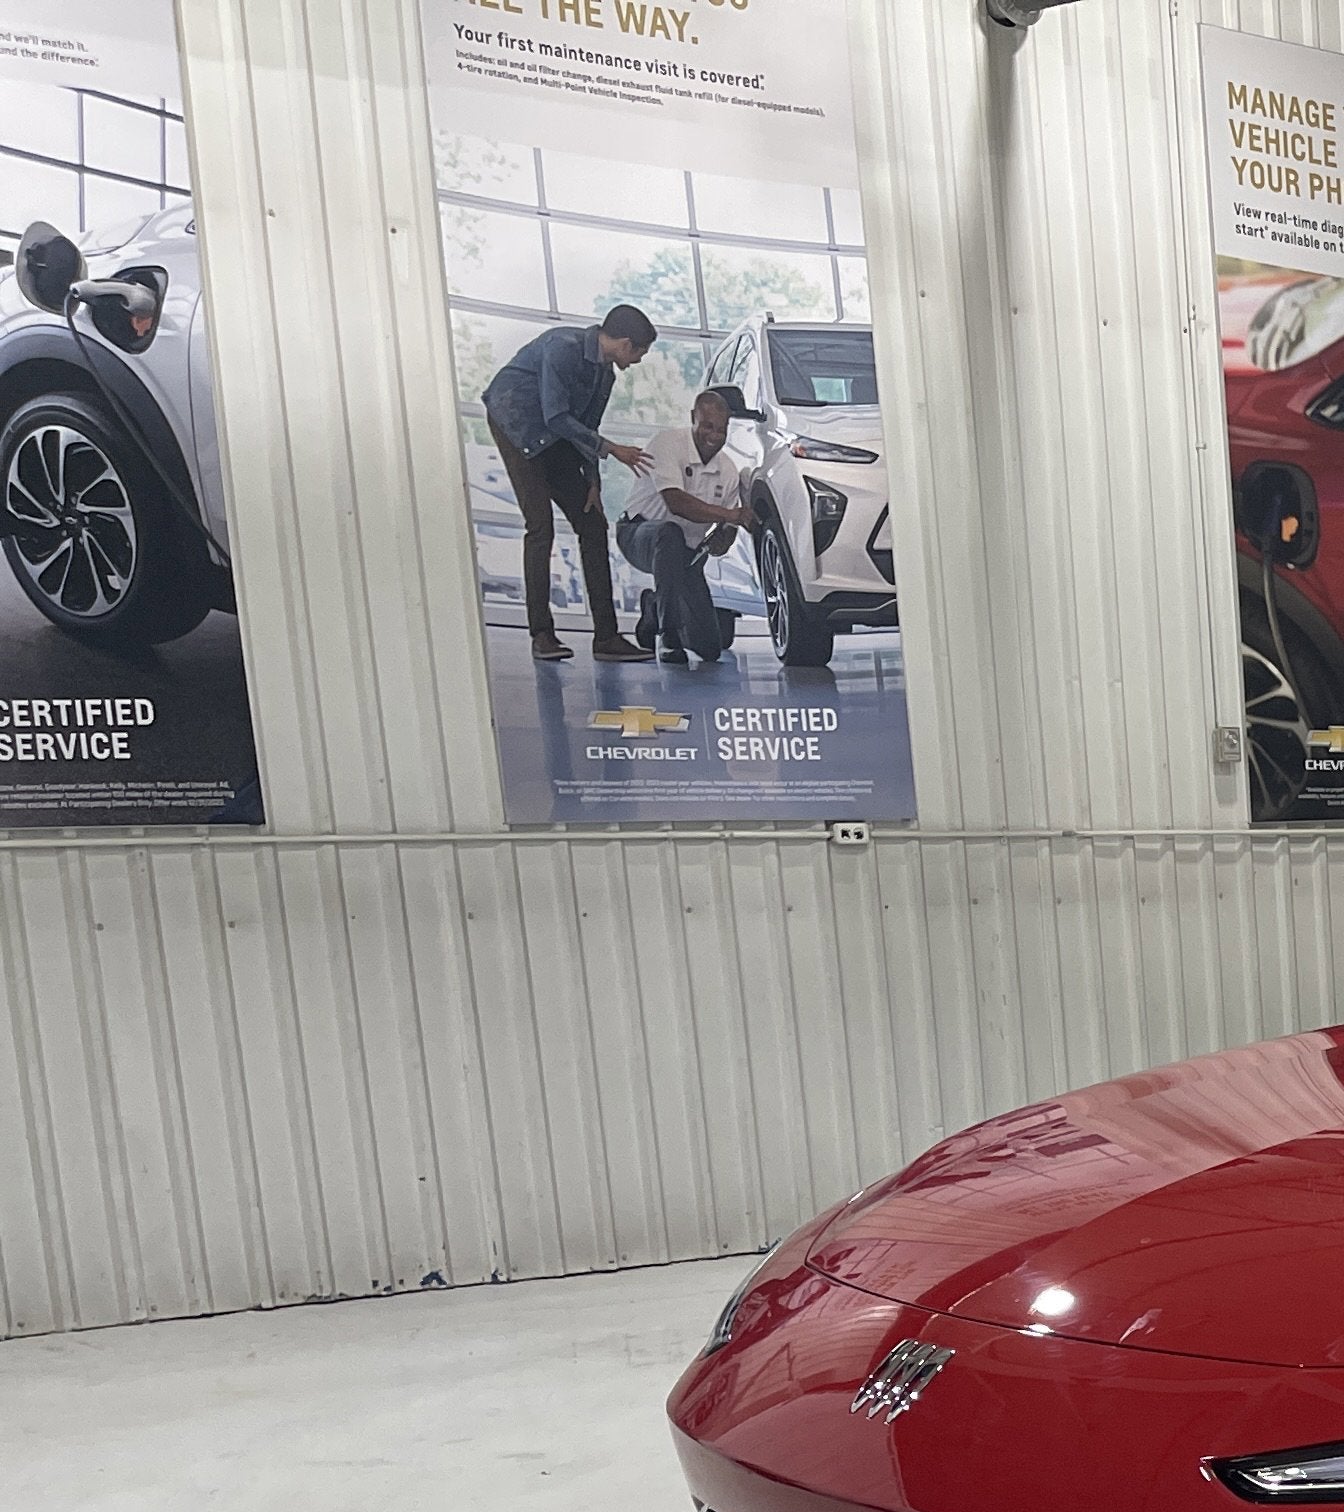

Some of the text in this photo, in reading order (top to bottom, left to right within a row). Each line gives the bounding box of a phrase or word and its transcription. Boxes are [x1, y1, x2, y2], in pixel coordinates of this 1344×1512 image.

[615, 0, 699, 45] WAY.
[0, 32, 12, 42] nd
[14, 34, 39, 46] we'll
[41, 39, 74, 50] match
[20, 48, 38, 60] the
[453, 22, 492, 45] Your
[497, 31, 534, 53] first
[539, 42, 641, 71] maintenance
[645, 59, 679, 78] visit
[683, 64, 696, 80] is
[455, 49, 496, 66] Includes:
[497, 58, 508, 67] oil
[510, 60, 526, 71] and
[527, 63, 538, 73] oil
[539, 65, 560, 77] filter
[562, 69, 595, 84] change,
[596, 74, 620, 88] diesel
[622, 80, 653, 92] exhaust
[655, 84, 674, 96] fluid
[675, 88, 692, 99] tank
[694, 90, 714, 102] refill
[714, 92, 730, 105] (for
[730, 96, 792, 113] diesel-equipped
[457, 62, 483, 75] 4-tire
[484, 68, 522, 83] rotation,
[523, 75, 539, 86] and
[540, 78, 587, 94] Multi-Point
[588, 86, 618, 99] Vehicle
[1227, 81, 1336, 132] MANAGE
[1228, 118, 1338, 169] VEHICLE
[1231, 155, 1300, 198] YOUR
[1234, 202, 1262, 220] View
[1265, 208, 1318, 232] real-time
[1271, 228, 1320, 250] available
[1324, 240, 1336, 252] on
[0, 698, 155, 728] CERTIFIED
[714, 707, 838, 733] CERTIFIED
[0, 732, 131, 762] SERVICE
[586, 746, 698, 761] CHEVROLET
[718, 736, 822, 761] SERVICE
